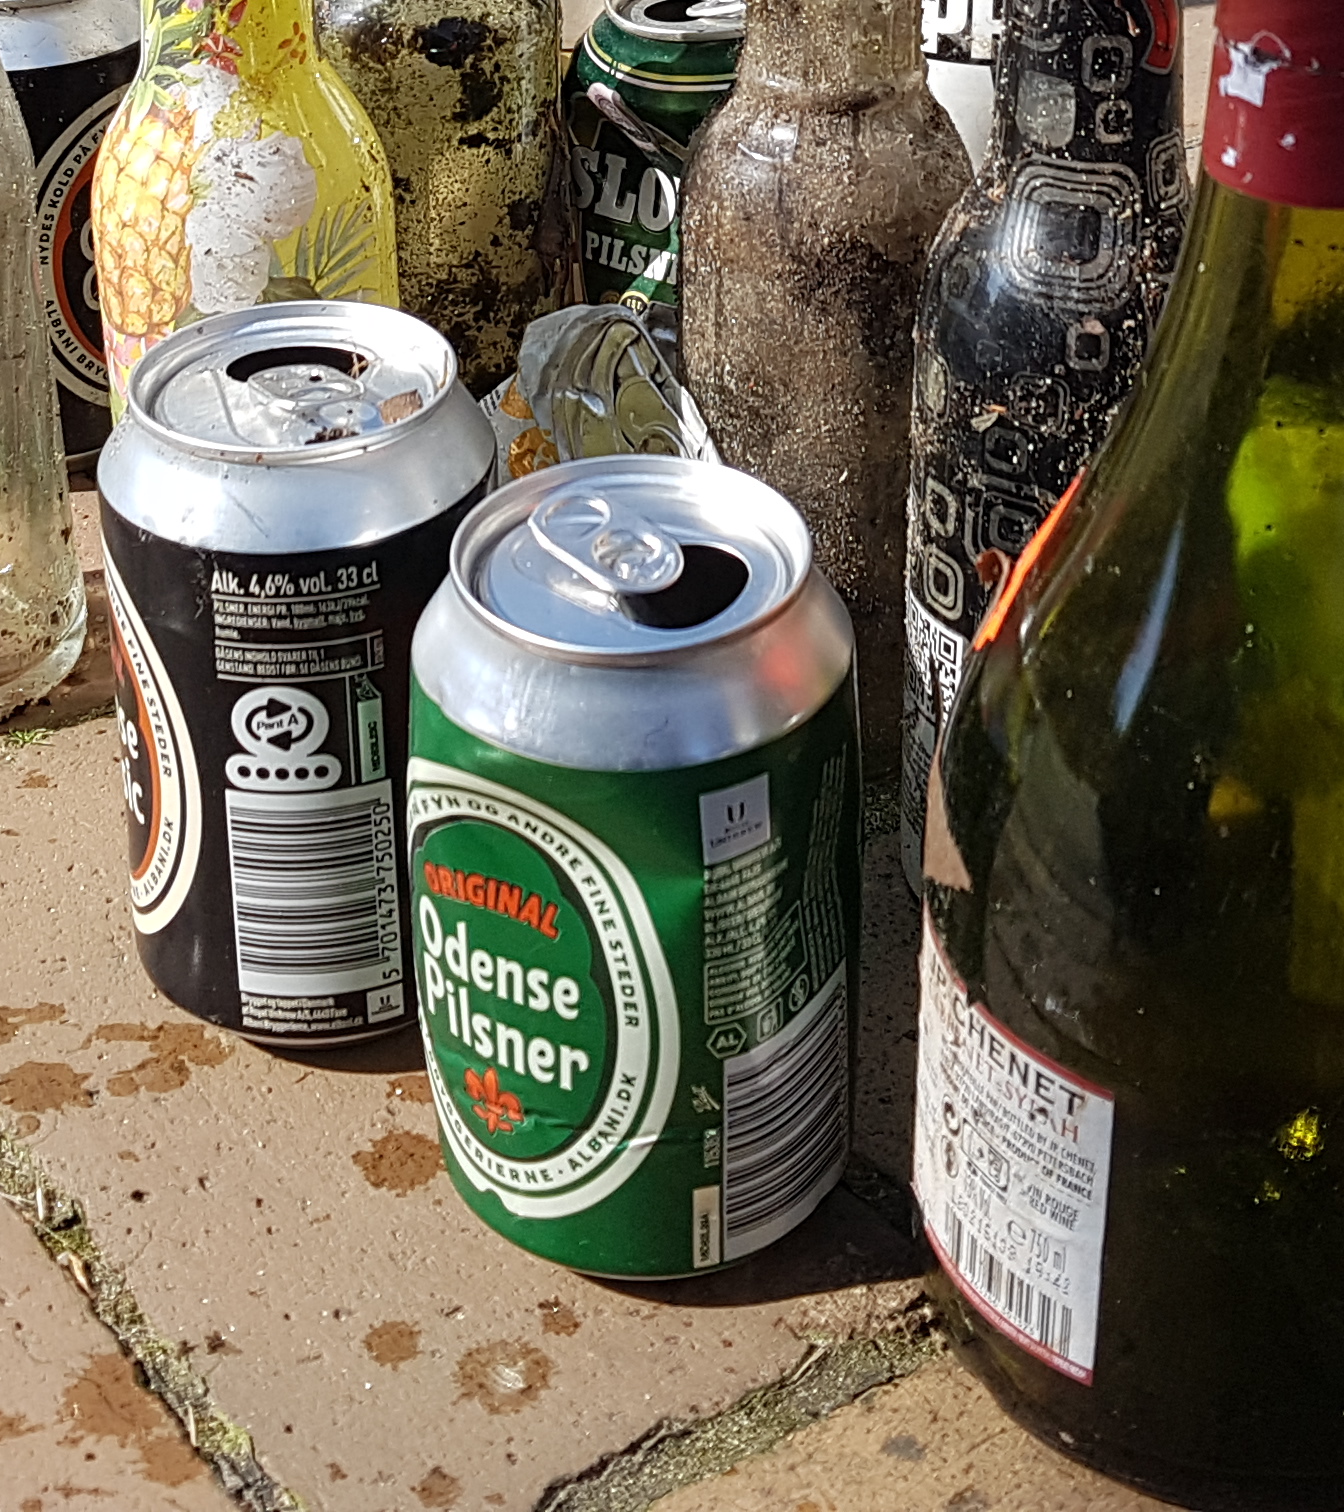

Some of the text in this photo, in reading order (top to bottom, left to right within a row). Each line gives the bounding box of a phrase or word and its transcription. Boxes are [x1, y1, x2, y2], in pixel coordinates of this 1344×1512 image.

[40, 124, 108, 265] NYDES KOLD PÅ FY
[570, 144, 680, 234] SLO
[45, 300, 78, 353] ALBANI
[212, 560, 380, 601] Alk. 4,6% vol. 33 cl
[127, 638, 149, 690] FINE
[147, 697, 172, 778] STEDER
[256, 713, 299, 731] Pant A
[144, 816, 174, 897] ALBANI.DK
[374, 802, 394, 877] 750250
[423, 860, 560, 940] ORIGINAL
[467, 800, 499, 816] OG
[507, 813, 583, 872] ANDRE
[581, 875, 617, 932] FINE
[608, 939, 639, 1028] STEDER
[419, 894, 580, 1020] Odense
[423, 950, 590, 1091] Pilsner
[954, 997, 1086, 1116] CHENET
[566, 1072, 637, 1171] ALBANI.DK
[1057, 1174, 1093, 1201] FRANCE
